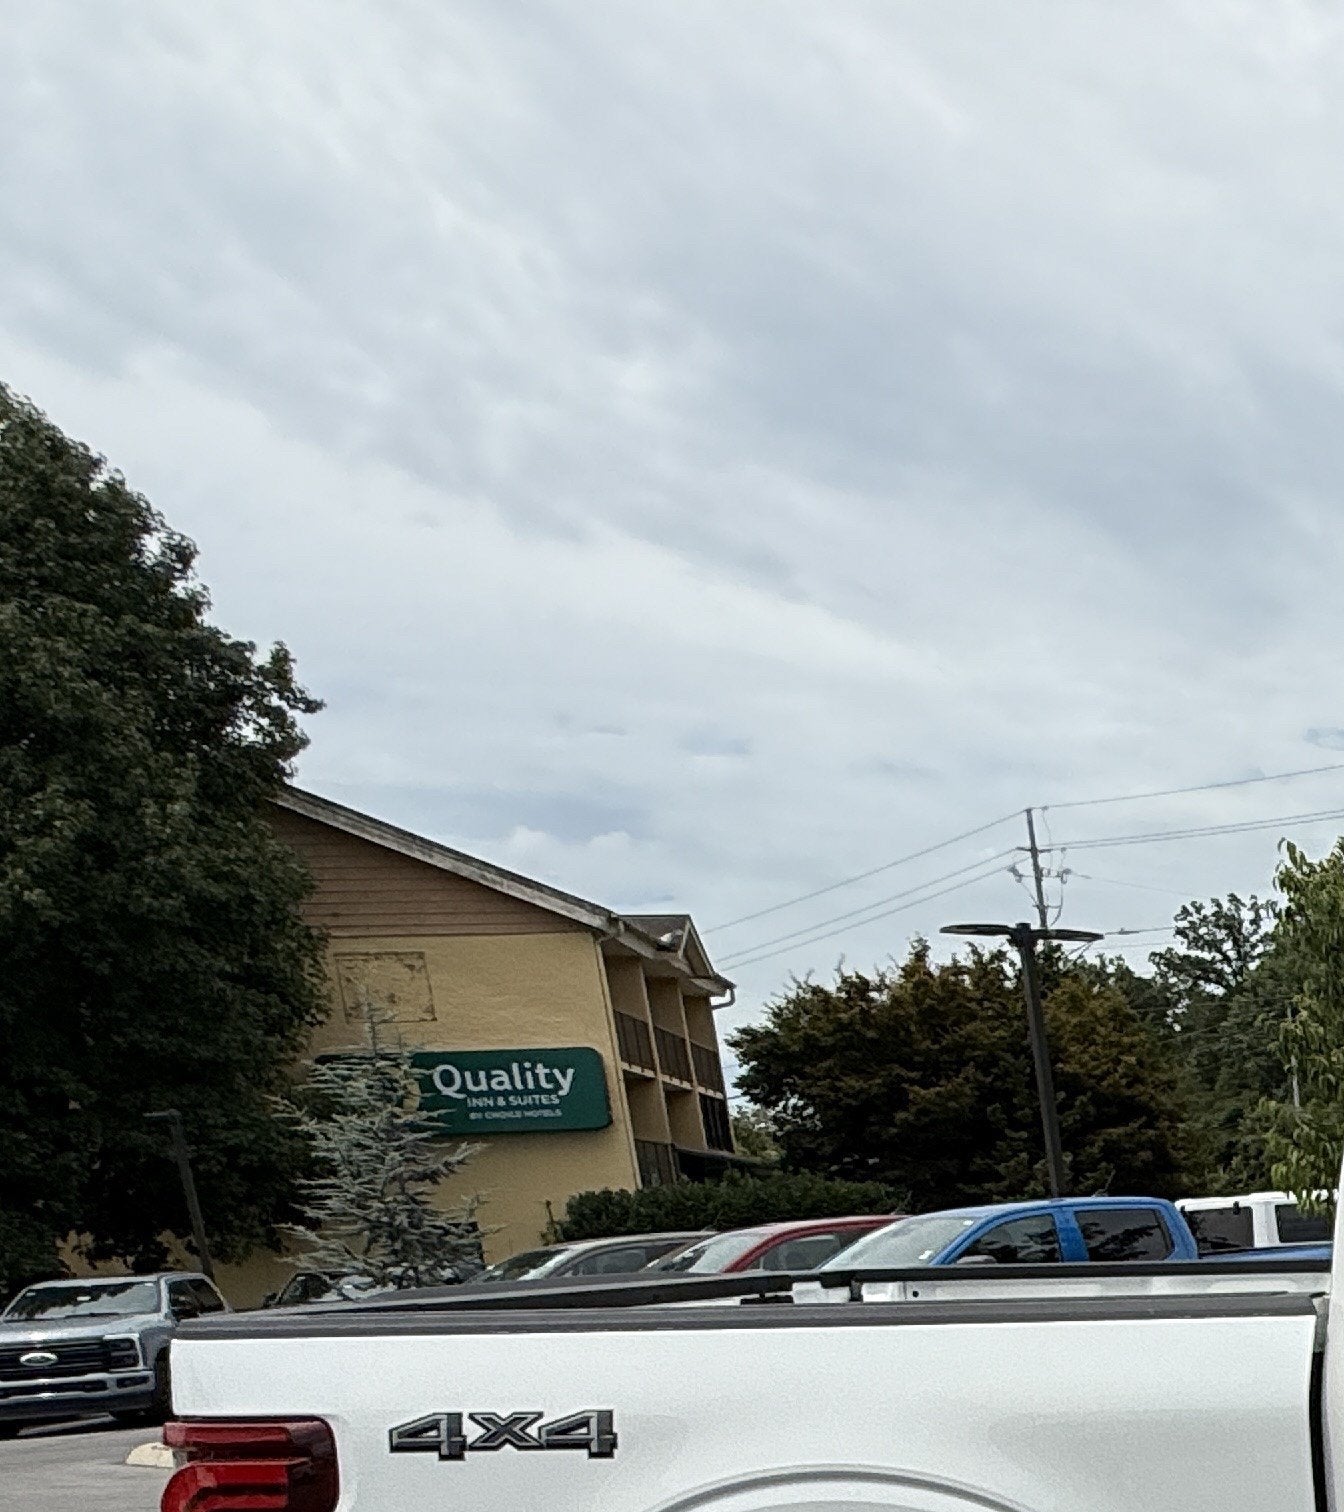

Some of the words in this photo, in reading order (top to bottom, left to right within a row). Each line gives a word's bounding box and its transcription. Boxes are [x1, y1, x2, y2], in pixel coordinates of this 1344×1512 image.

[432, 1062, 575, 1099] Quality
[466, 1097, 494, 1108] INN
[497, 1096, 506, 1106] &
[508, 1094, 560, 1107] SUITES
